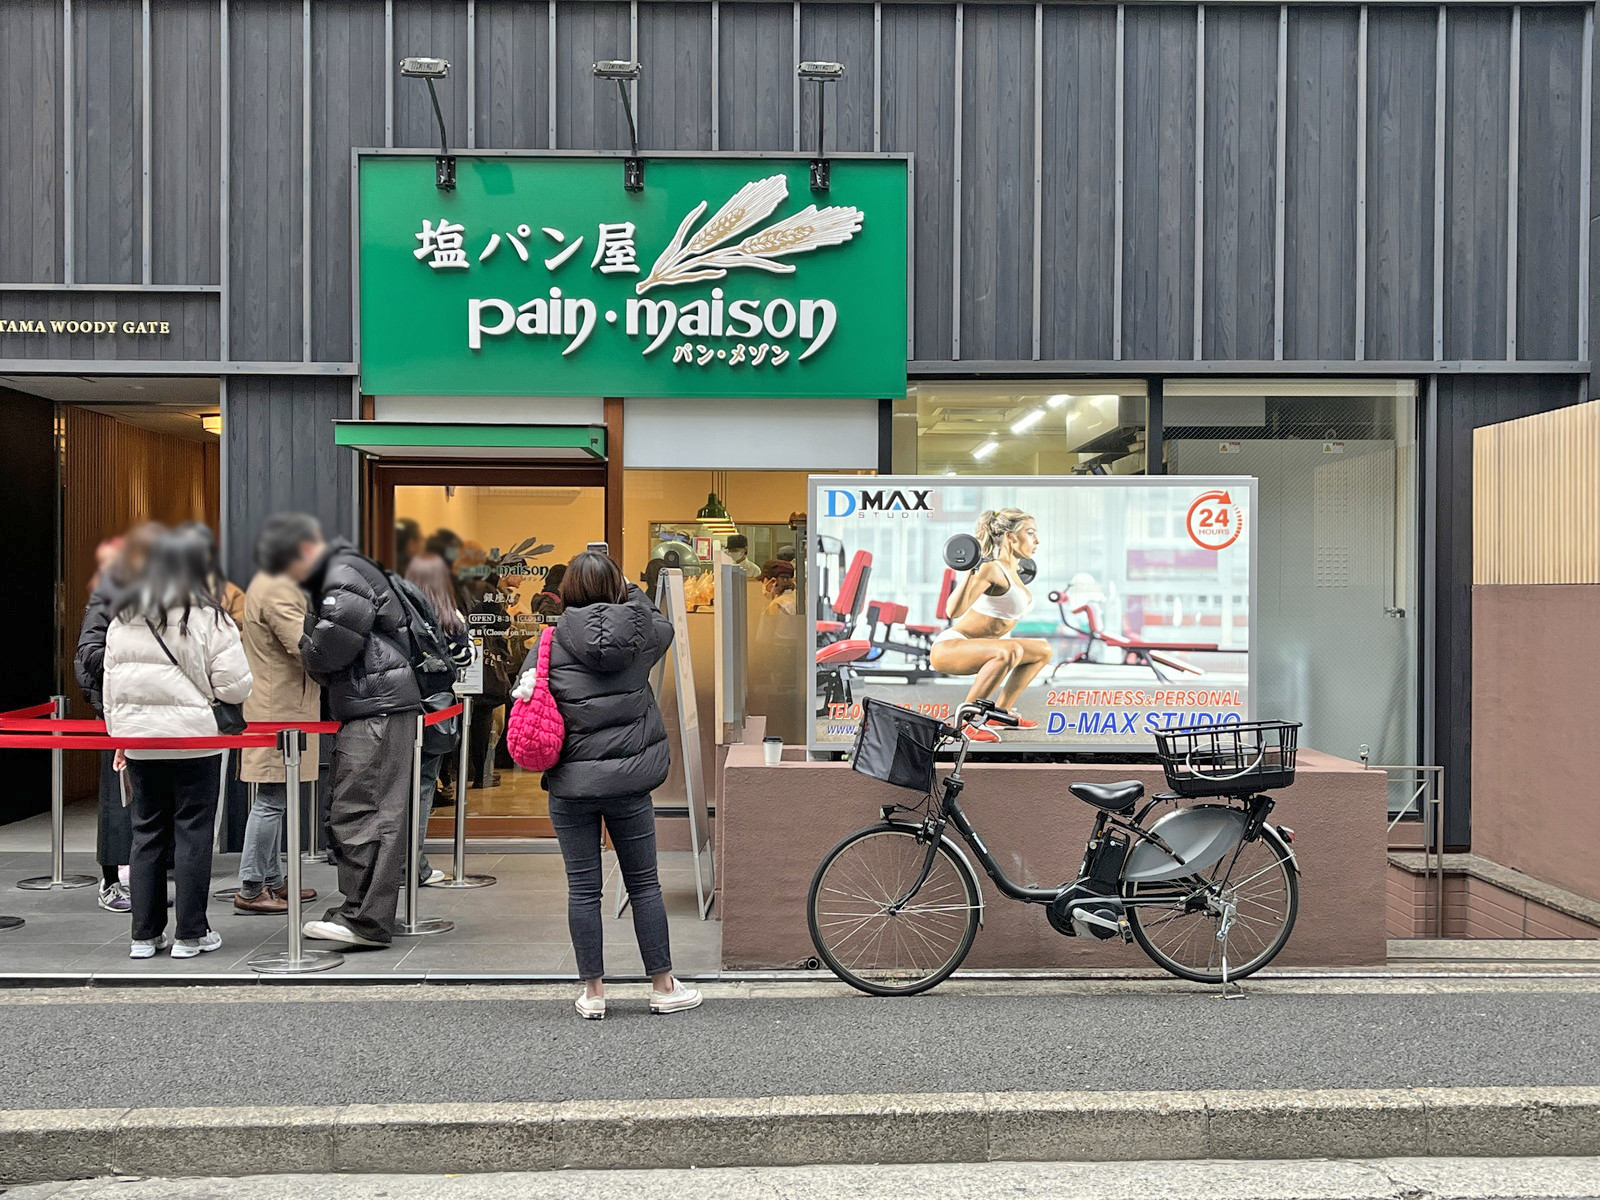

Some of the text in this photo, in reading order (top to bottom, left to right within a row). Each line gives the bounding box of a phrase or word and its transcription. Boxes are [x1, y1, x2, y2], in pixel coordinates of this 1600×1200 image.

[413, 218, 641, 274] 塩パン屋
[50, 320, 118, 334] WOODY
[122, 321, 170, 334] GATE
[672, 342, 790, 366] パン・メゾン
[858, 511, 934, 519] STUDIO
[1199, 508, 1230, 527] 24
[1198, 528, 1230, 536] HOURS
[1046, 690, 1243, 707] 24hFITNESS&PERSONAL
[1046, 712, 1140, 735] D-MAX
